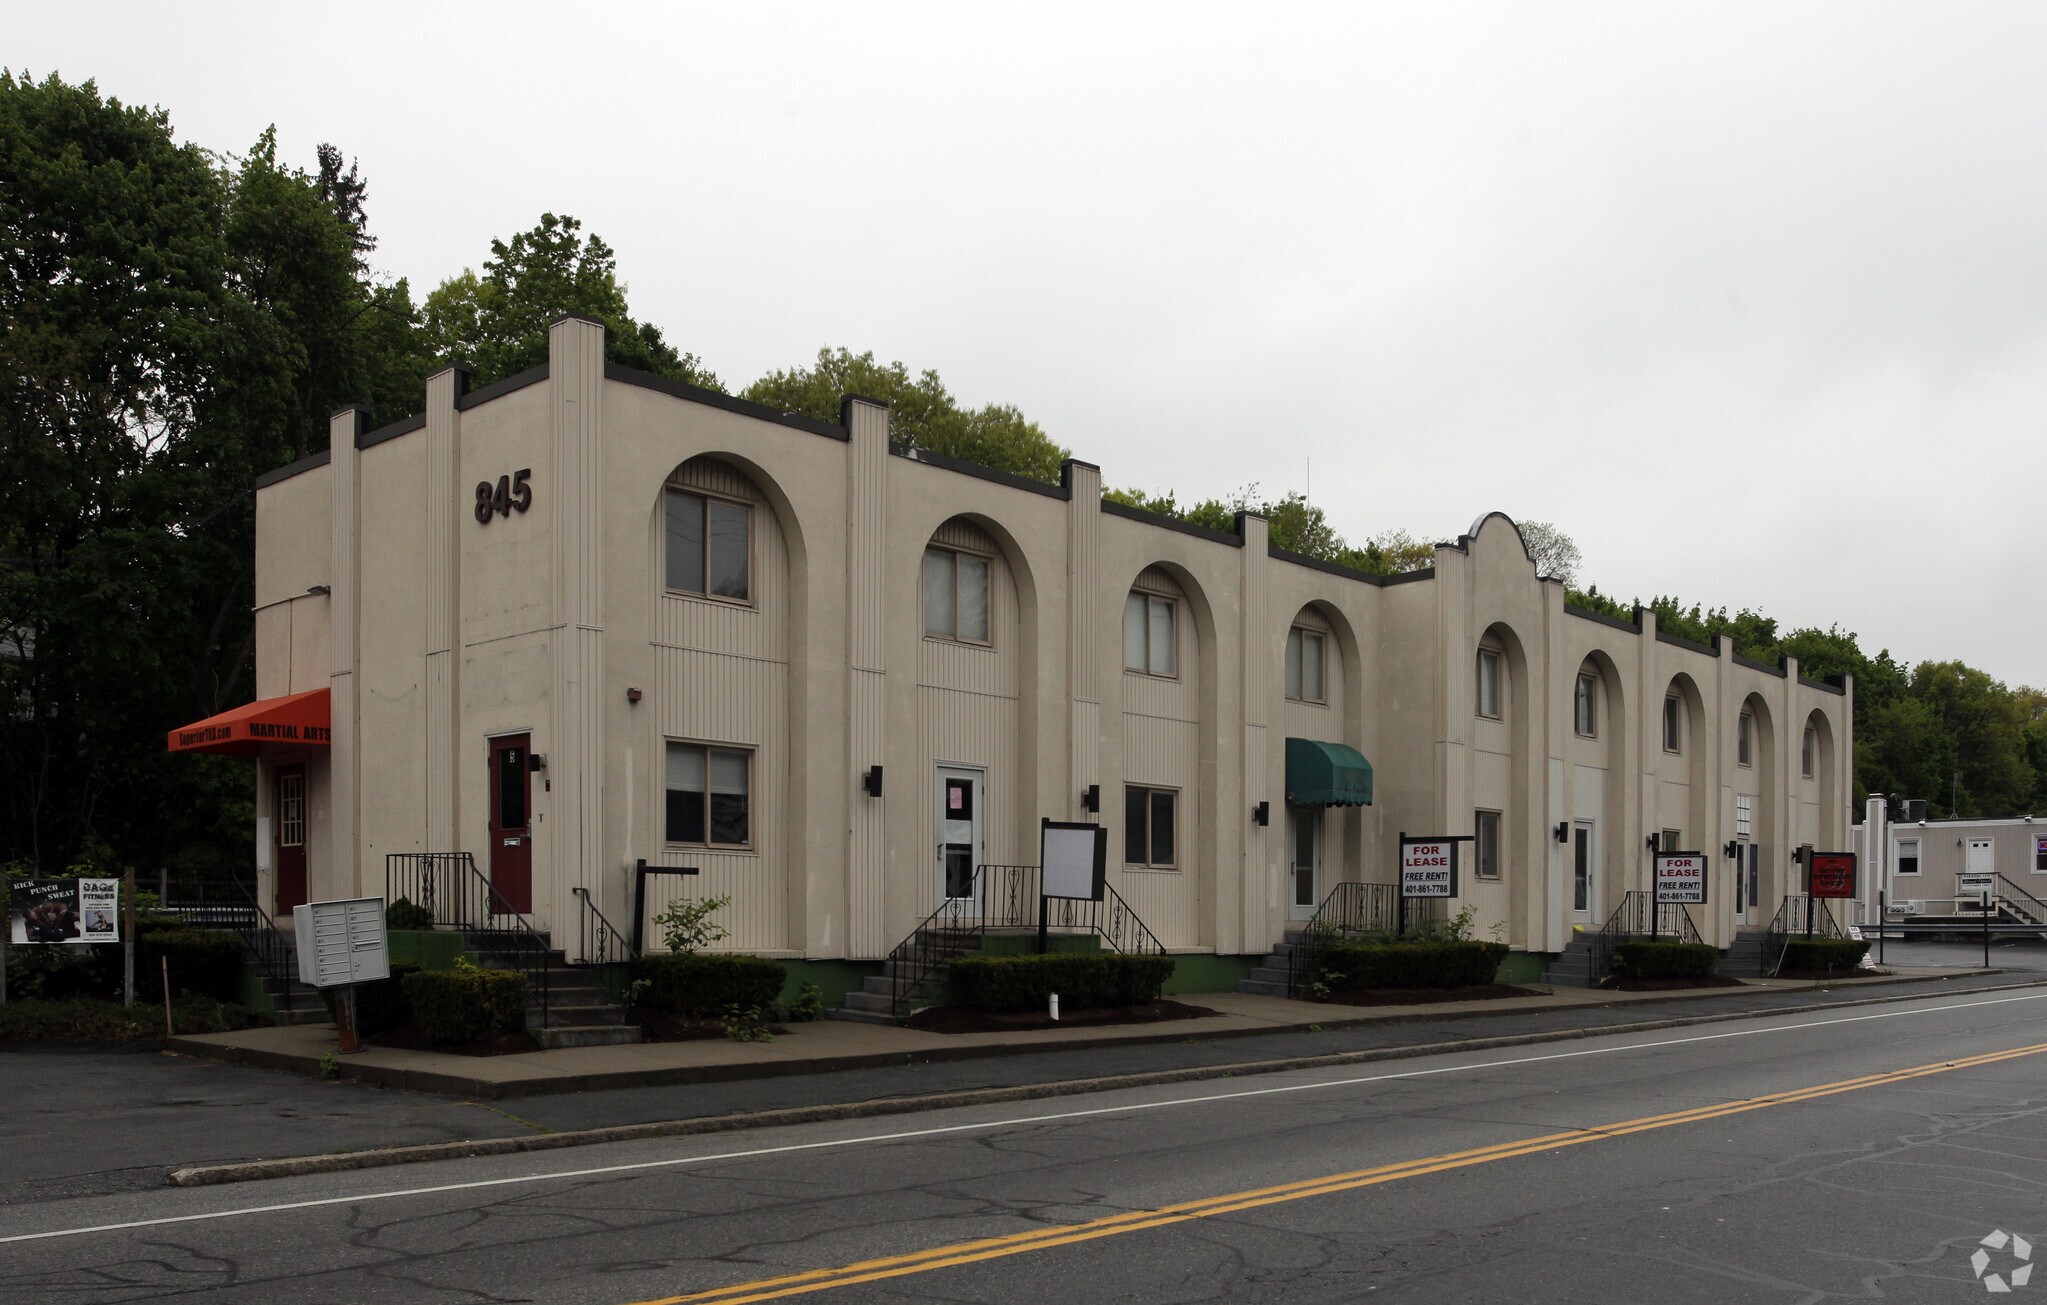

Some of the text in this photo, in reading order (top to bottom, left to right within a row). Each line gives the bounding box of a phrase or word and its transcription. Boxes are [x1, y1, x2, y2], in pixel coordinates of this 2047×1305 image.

[474, 468, 532, 524] 845
[250, 723, 331, 741] MARTIAL ARTS
[179, 727, 231, 747] SuperiorTKD.com
[1413, 846, 1440, 855] FOR
[1405, 857, 1448, 867] LEASE
[1667, 859, 1692, 867] FOR
[1405, 872, 1448, 880] FREE RENT!
[1659, 869, 1700, 877] LEASE
[13, 880, 35, 890] KICK
[1405, 885, 1448, 893] 401-861-7788
[1659, 881, 1700, 889] FREE RENT!
[30, 884, 59, 896] PUNCH
[47, 889, 75, 901] SWEAT
[1658, 892, 1700, 900] 401-861-7788
